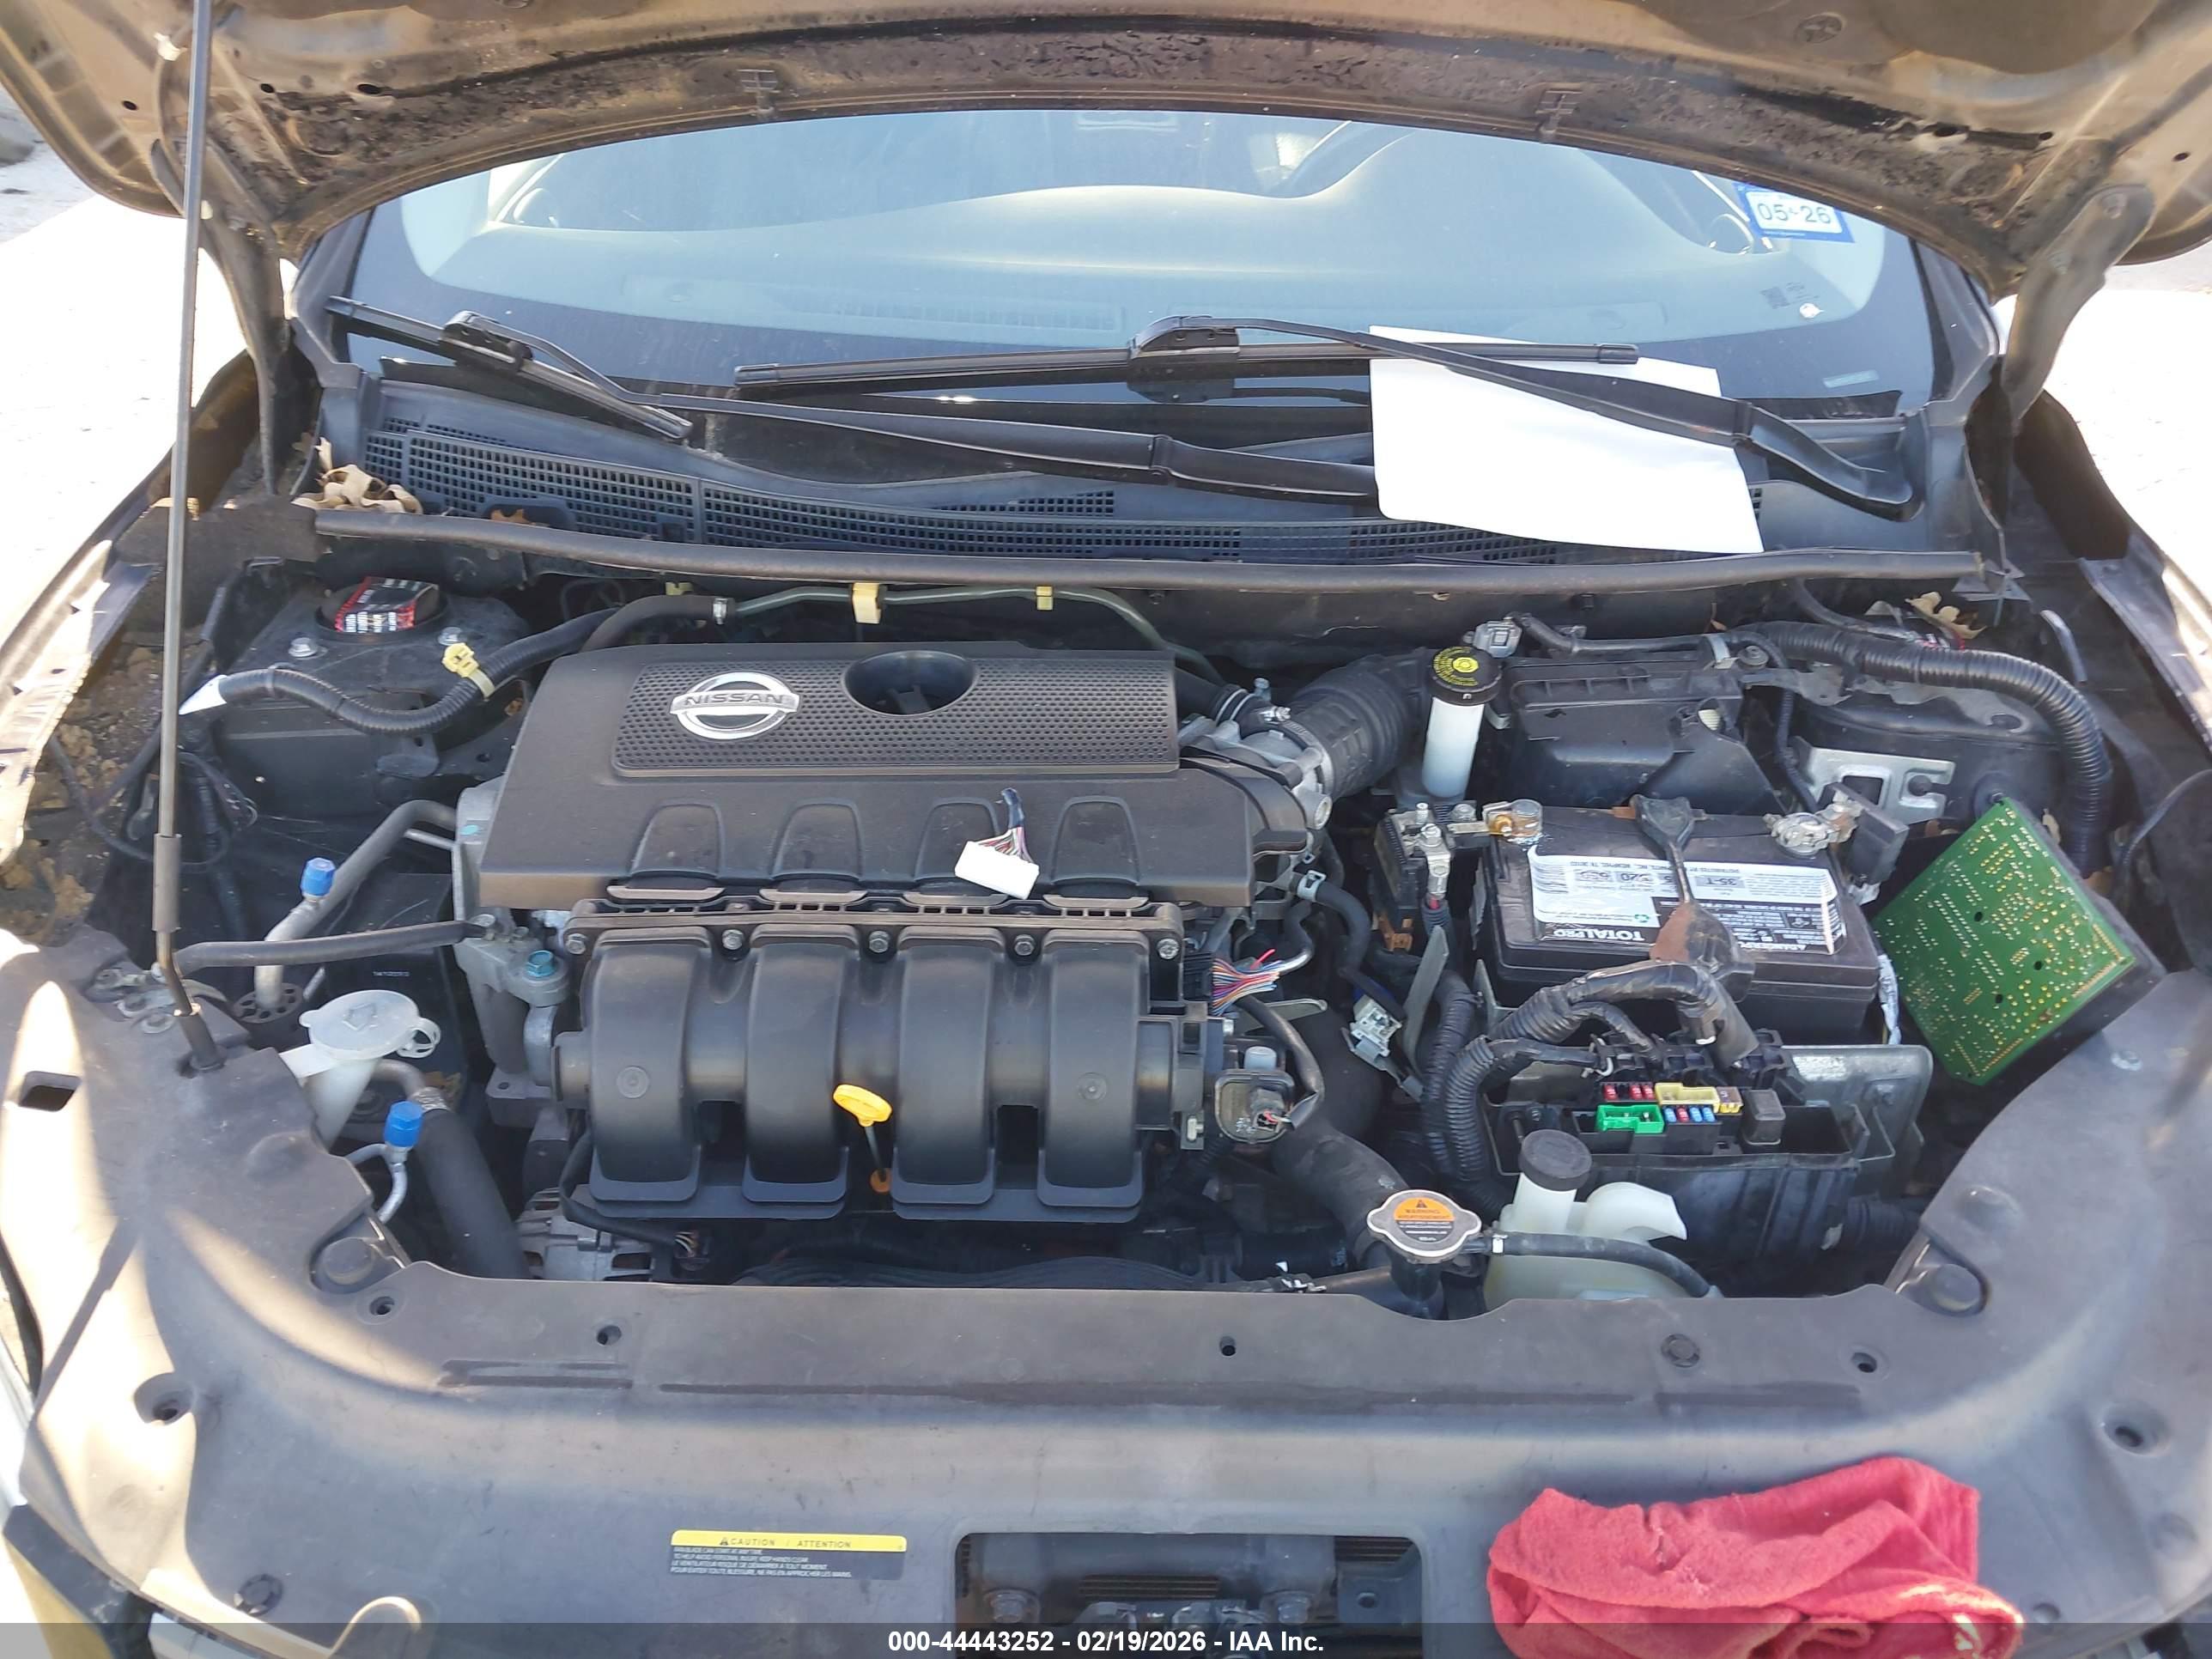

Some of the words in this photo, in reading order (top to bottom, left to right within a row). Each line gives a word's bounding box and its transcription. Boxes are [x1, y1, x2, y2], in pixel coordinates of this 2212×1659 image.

[684, 693, 783, 705] NISSAN
[1705, 878, 1736, 886] 35-T
[1553, 928, 1646, 942] TOTALPRO
[797, 1540, 852, 1548] ATTENTION
